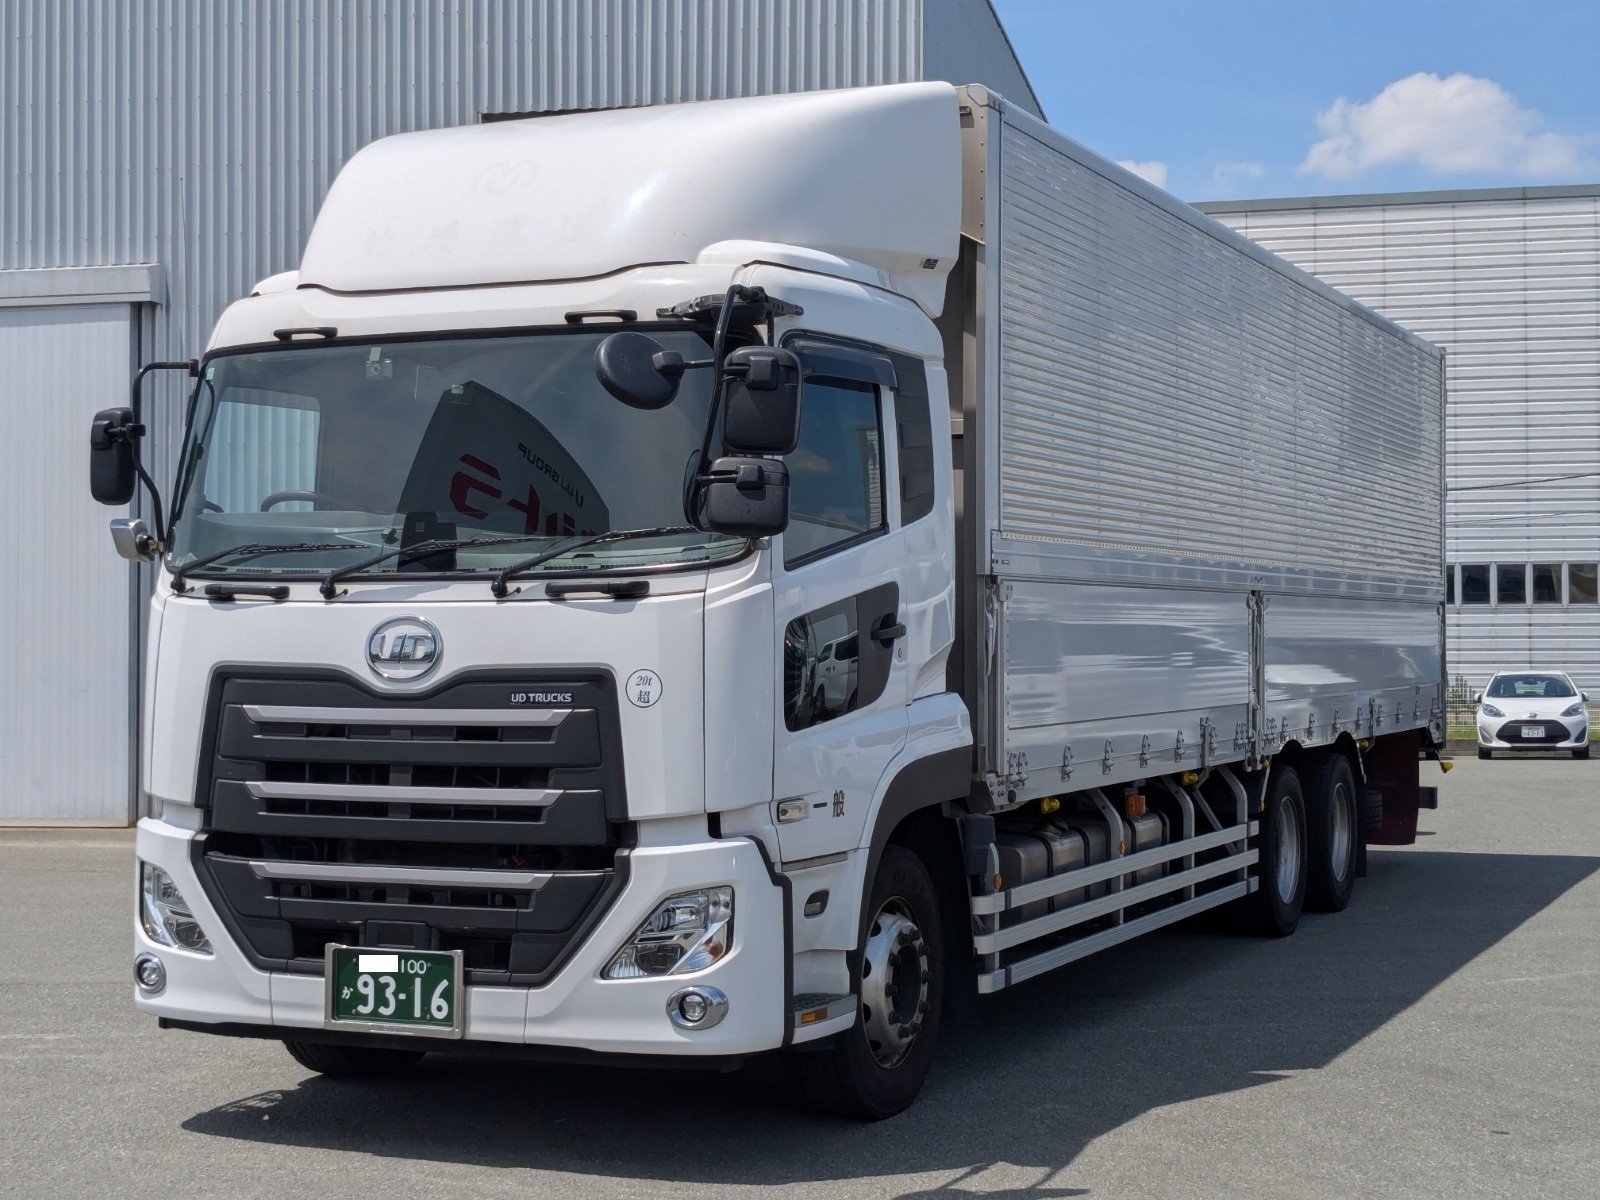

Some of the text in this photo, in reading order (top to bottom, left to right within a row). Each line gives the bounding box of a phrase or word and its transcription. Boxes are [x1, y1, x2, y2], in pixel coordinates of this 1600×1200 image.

[370, 633, 434, 662] UD
[636, 675, 653, 686] 20t
[511, 693, 572, 702] UD TRUCKS
[637, 690, 650, 704] 超
[401, 959, 427, 975] 100
[341, 974, 449, 1019] か 93-16
